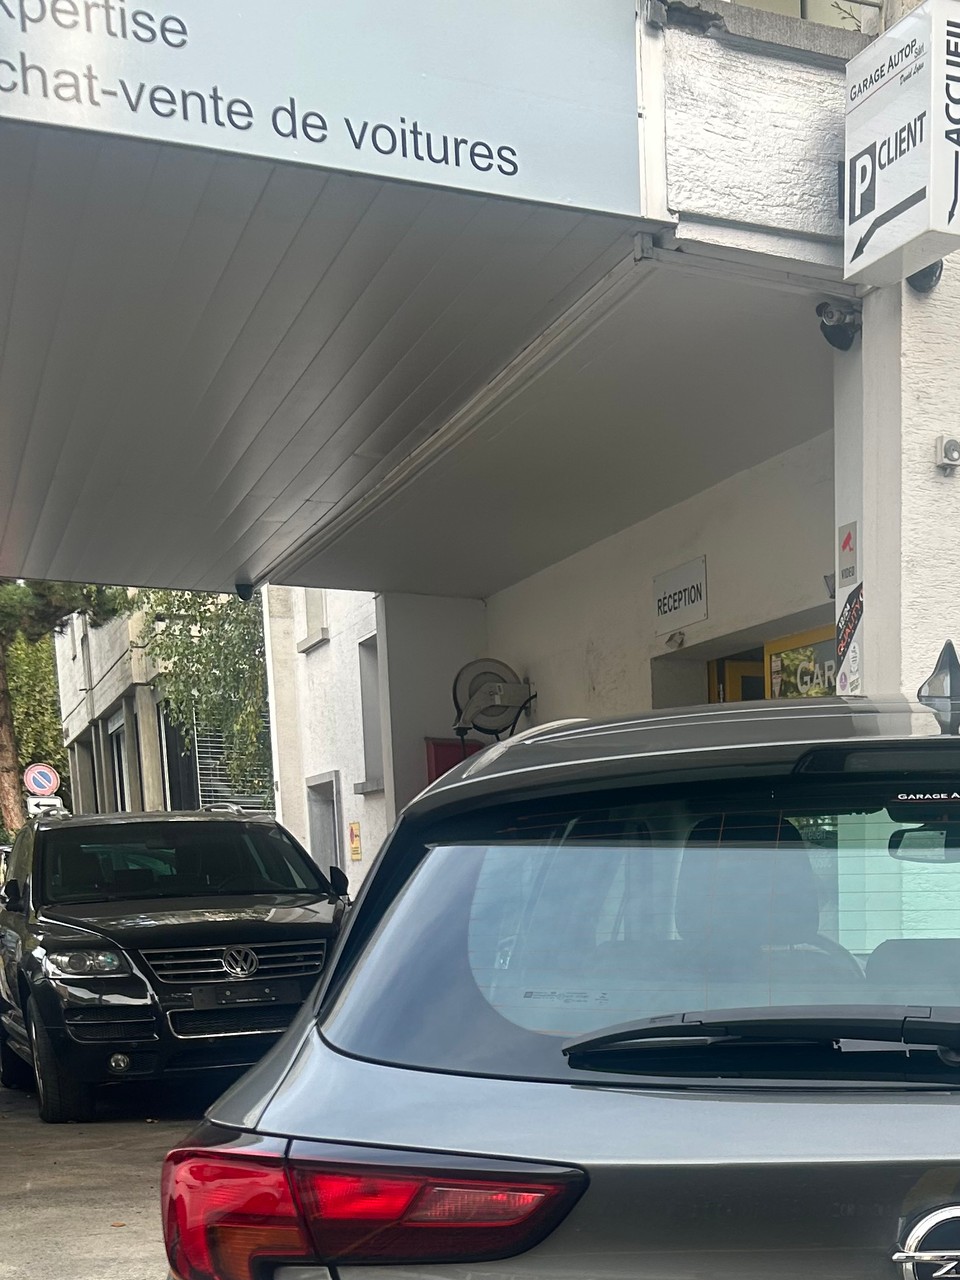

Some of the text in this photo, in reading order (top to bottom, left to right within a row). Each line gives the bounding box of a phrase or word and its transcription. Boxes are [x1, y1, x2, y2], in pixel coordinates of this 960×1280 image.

[850, 63, 886, 102] GARAGE
[887, 38, 917, 74] AUTOP
[272, 97, 328, 143] de
[345, 116, 519, 176] voitures
[854, 110, 927, 217] P CLIENT
[657, 582, 703, 617] RÉCEPTION
[898, 792, 948, 800] GARAGE
